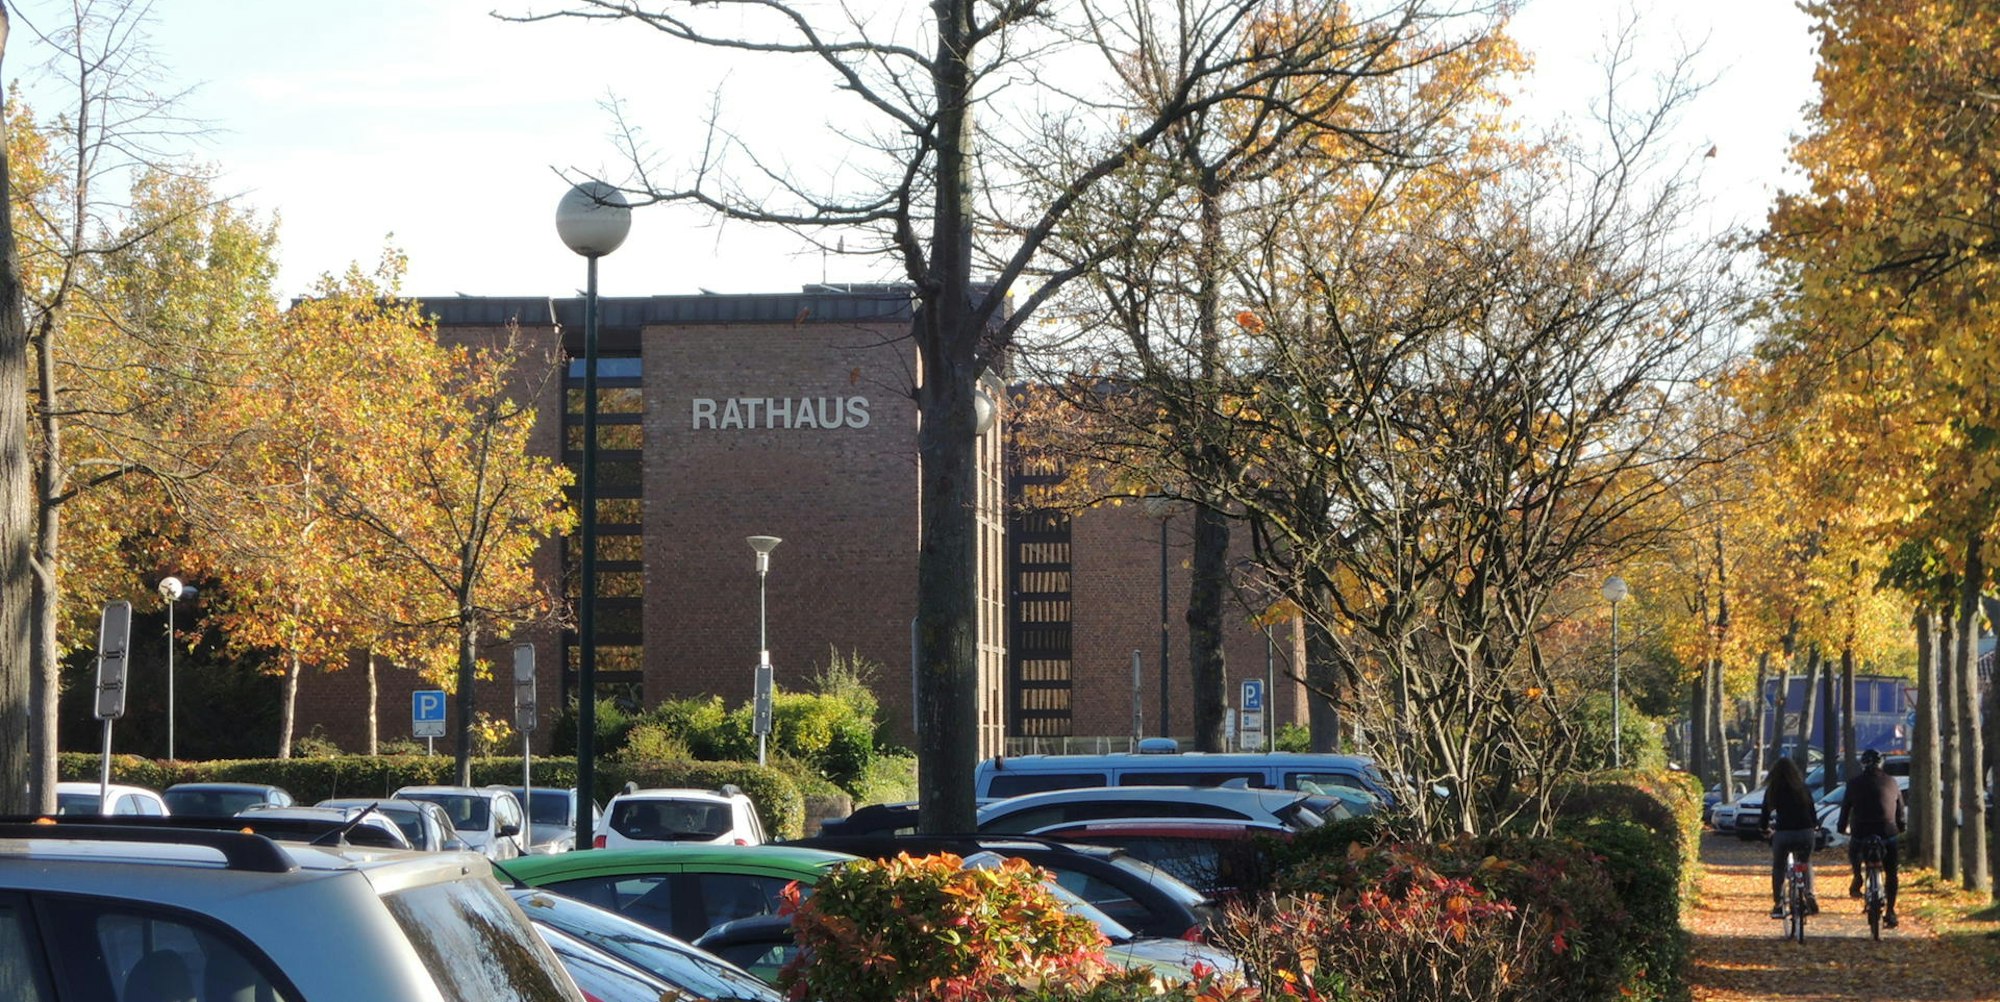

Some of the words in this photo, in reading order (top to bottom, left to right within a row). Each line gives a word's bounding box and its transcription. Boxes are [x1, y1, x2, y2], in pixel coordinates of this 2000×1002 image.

[692, 396, 871, 430] RATHAUS
[420, 695, 438, 720] P
[1245, 684, 1256, 707] P
